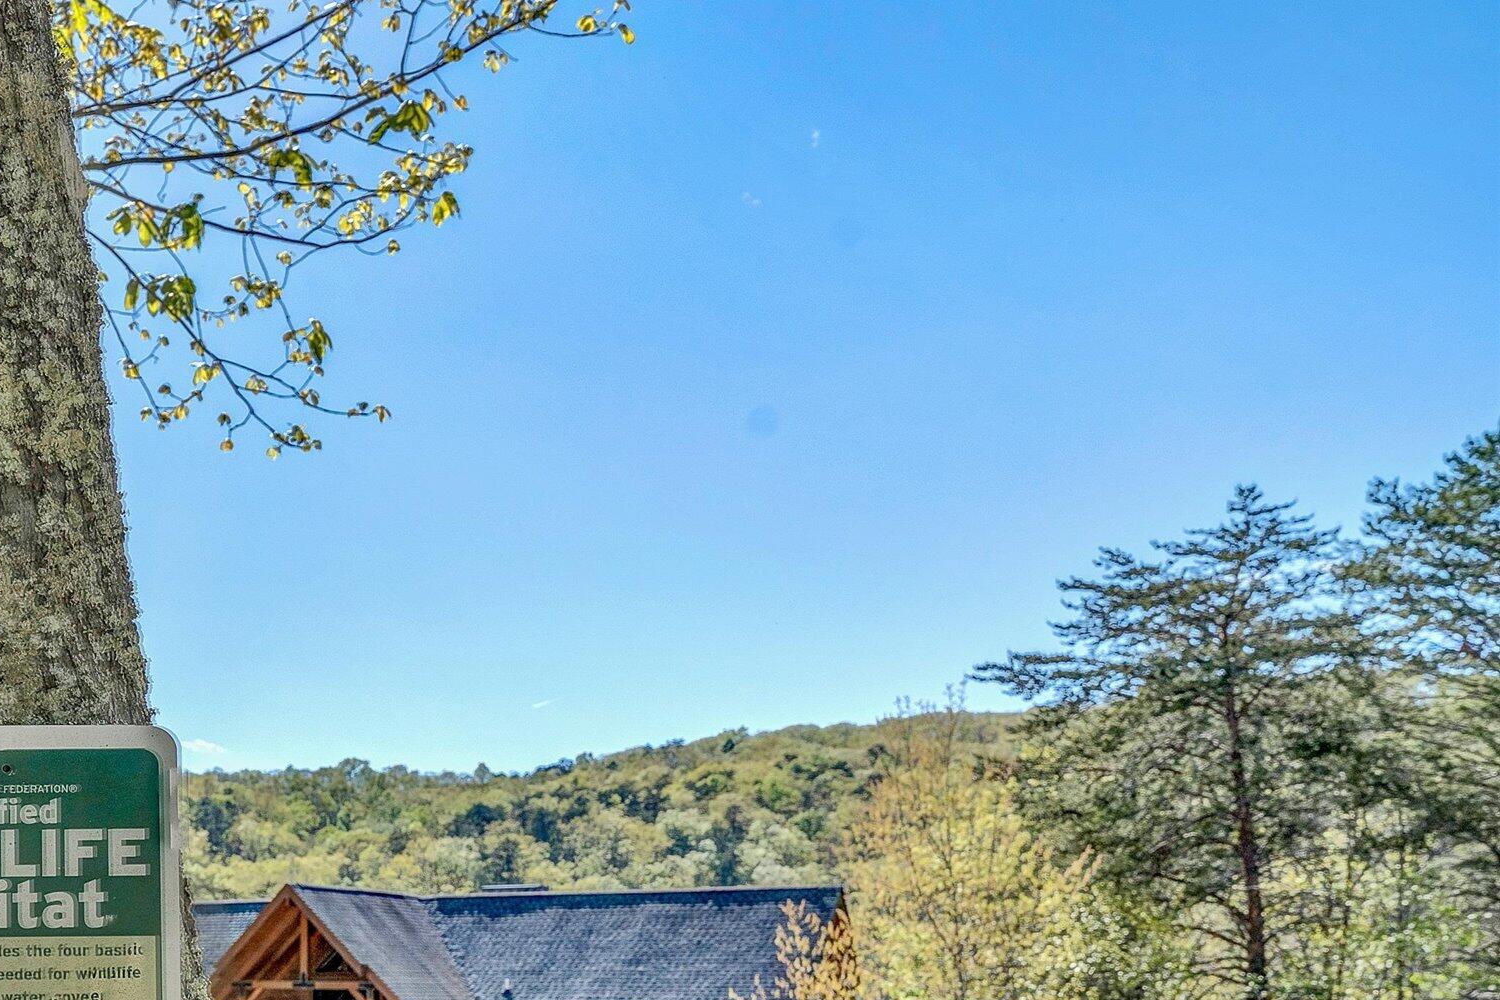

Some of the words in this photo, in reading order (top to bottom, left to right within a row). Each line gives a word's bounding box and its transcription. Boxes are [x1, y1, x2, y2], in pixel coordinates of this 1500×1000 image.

[26, 944, 52, 957] the
[58, 944, 89, 957] four
[48, 967, 70, 980] for
